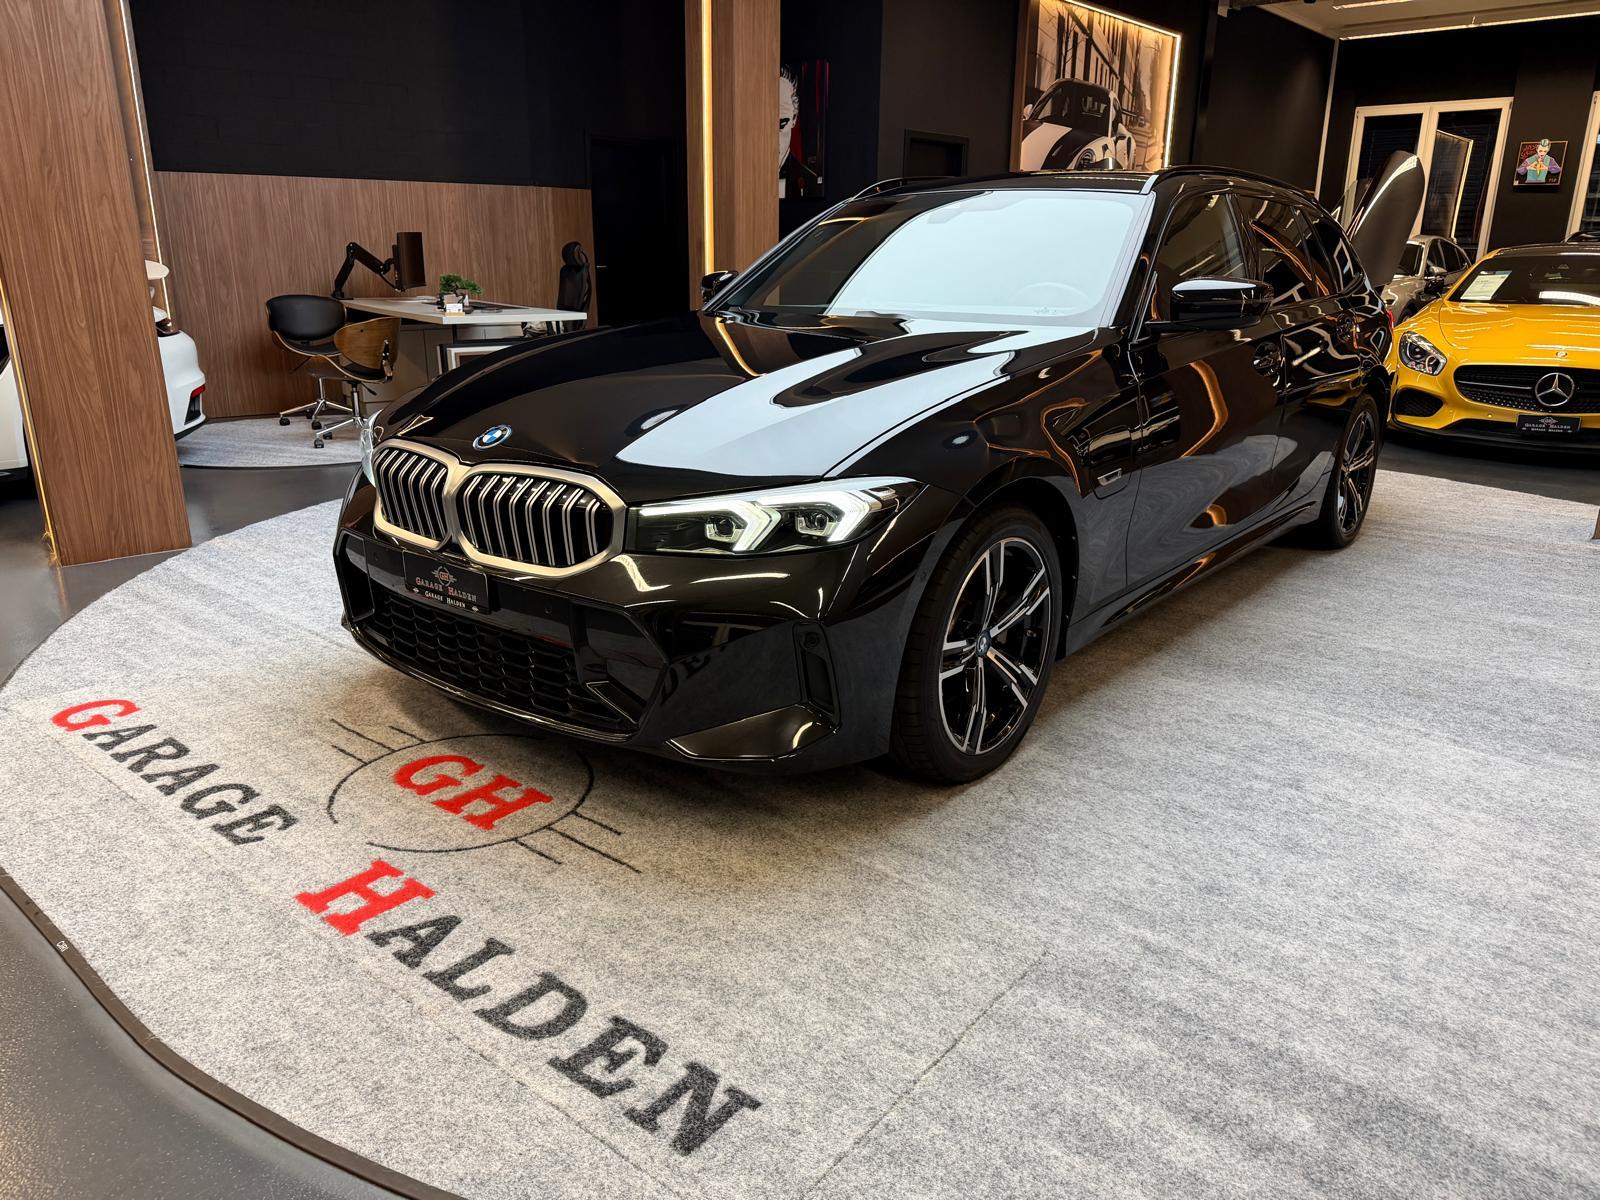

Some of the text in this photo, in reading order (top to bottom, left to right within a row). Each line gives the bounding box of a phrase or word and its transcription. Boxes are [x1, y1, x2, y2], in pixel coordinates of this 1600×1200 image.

[415, 576, 477, 603] GARAGE HALDEN
[424, 590, 466, 608] GARAGE HALDEN
[393, 755, 554, 831] GH
[51, 699, 762, 1156] GARAGE HALDEN
